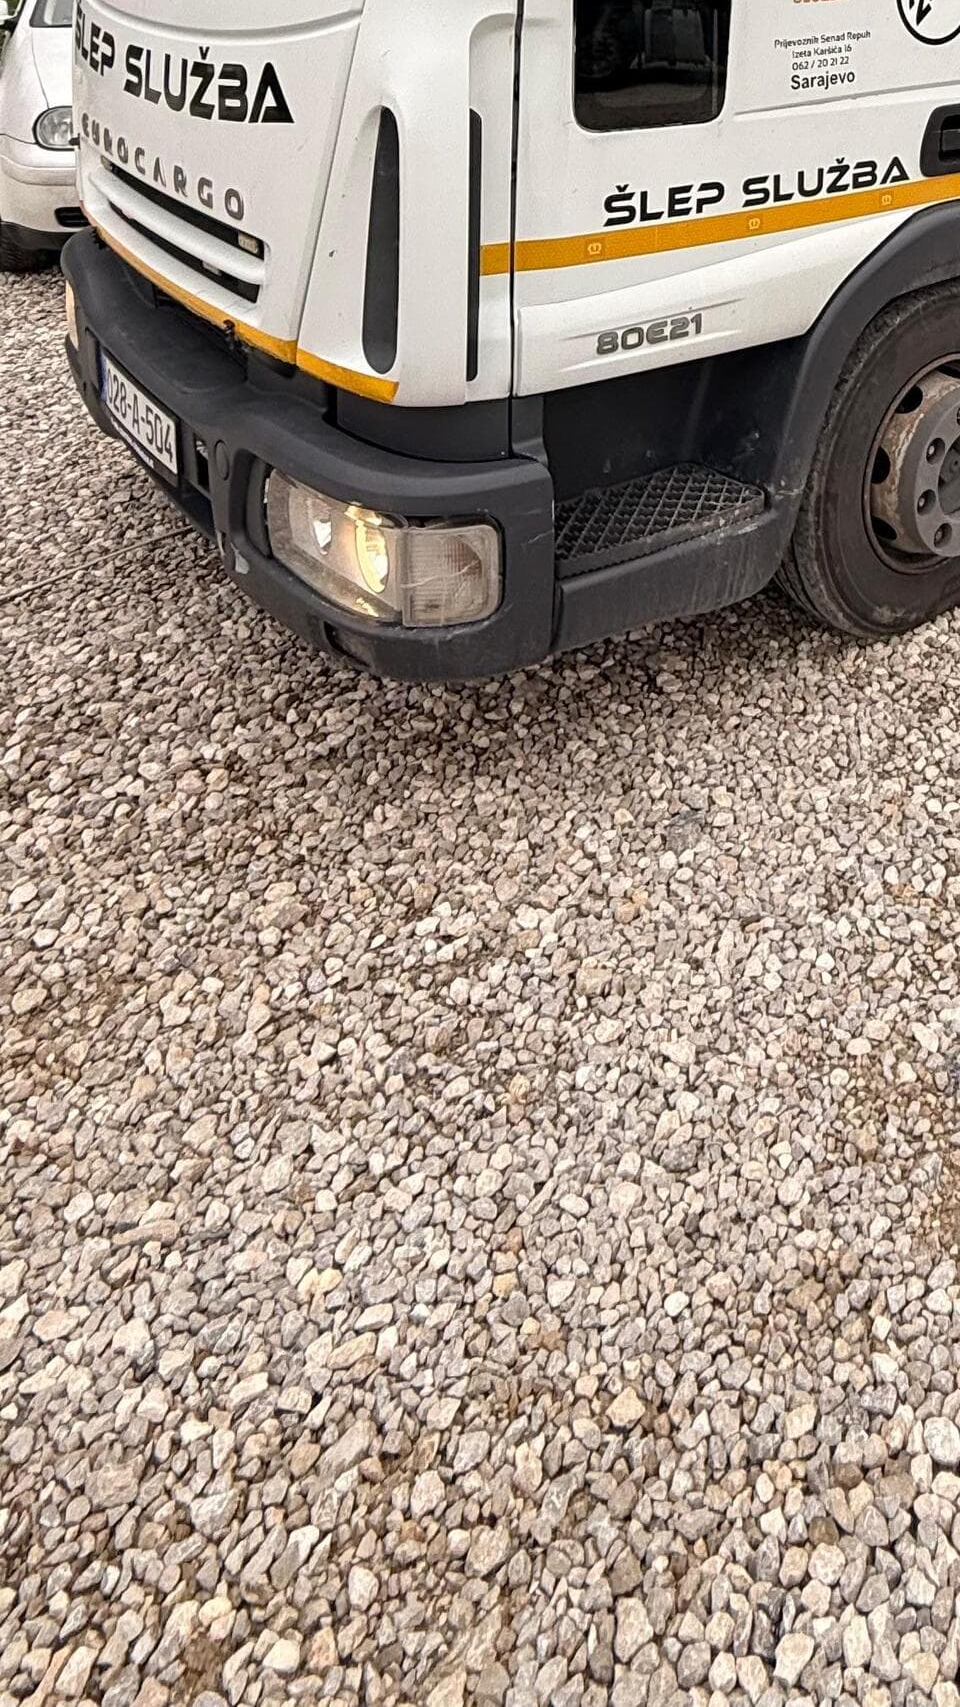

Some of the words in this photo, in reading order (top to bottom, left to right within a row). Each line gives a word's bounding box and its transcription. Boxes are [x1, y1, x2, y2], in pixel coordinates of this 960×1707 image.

[774, 35, 819, 50] Prijevoznik
[820, 32, 846, 44] Senad
[123, 46, 295, 124] SLUŽBA
[790, 71, 856, 90] Sarajevo
[791, 60, 810, 71] 062
[817, 58, 829, 69] 20
[830, 57, 838, 67] 21
[839, 56, 850, 66] 22
[81, 112, 245, 221] EUROCARGO
[603, 183, 726, 228] ŠLEP
[742, 156, 911, 208] SLUŽBA
[596, 313, 704, 356] 80E21
